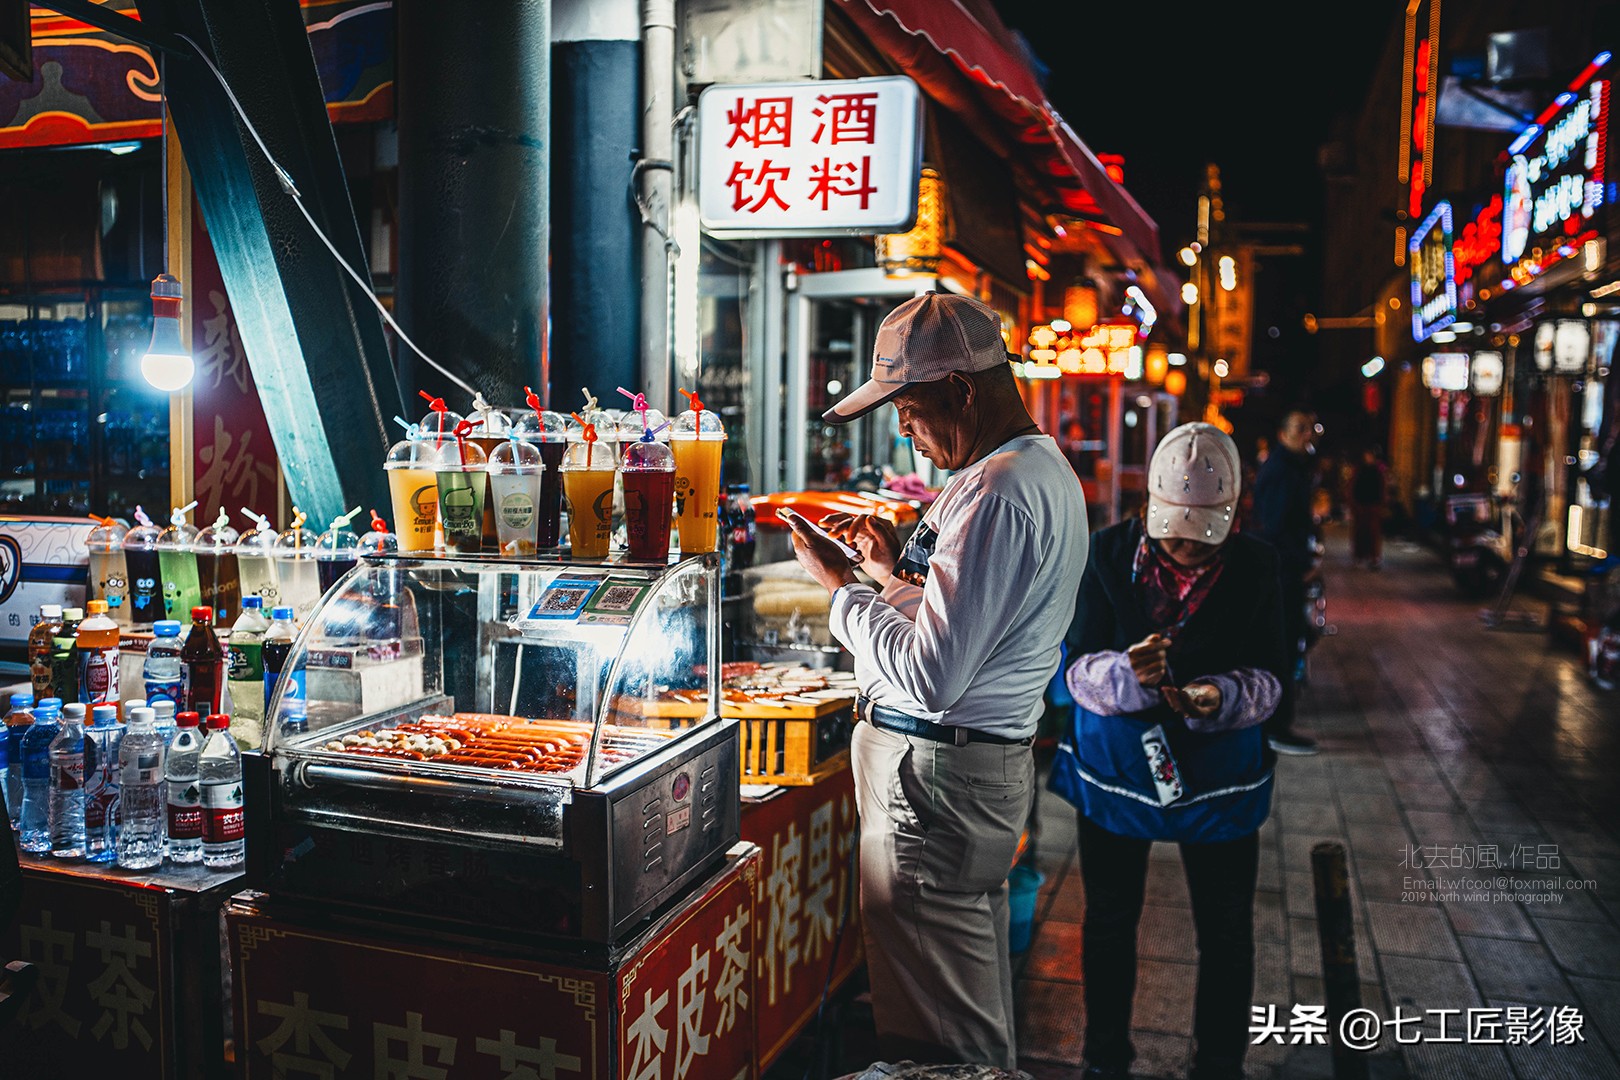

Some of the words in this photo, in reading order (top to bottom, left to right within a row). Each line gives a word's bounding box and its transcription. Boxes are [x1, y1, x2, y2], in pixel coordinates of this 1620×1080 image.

[725, 92, 879, 149] 烟酒
[725, 155, 878, 213] 饮料
[756, 793, 860, 1006] 榨果汁
[627, 904, 751, 1080] 杏皮茶
